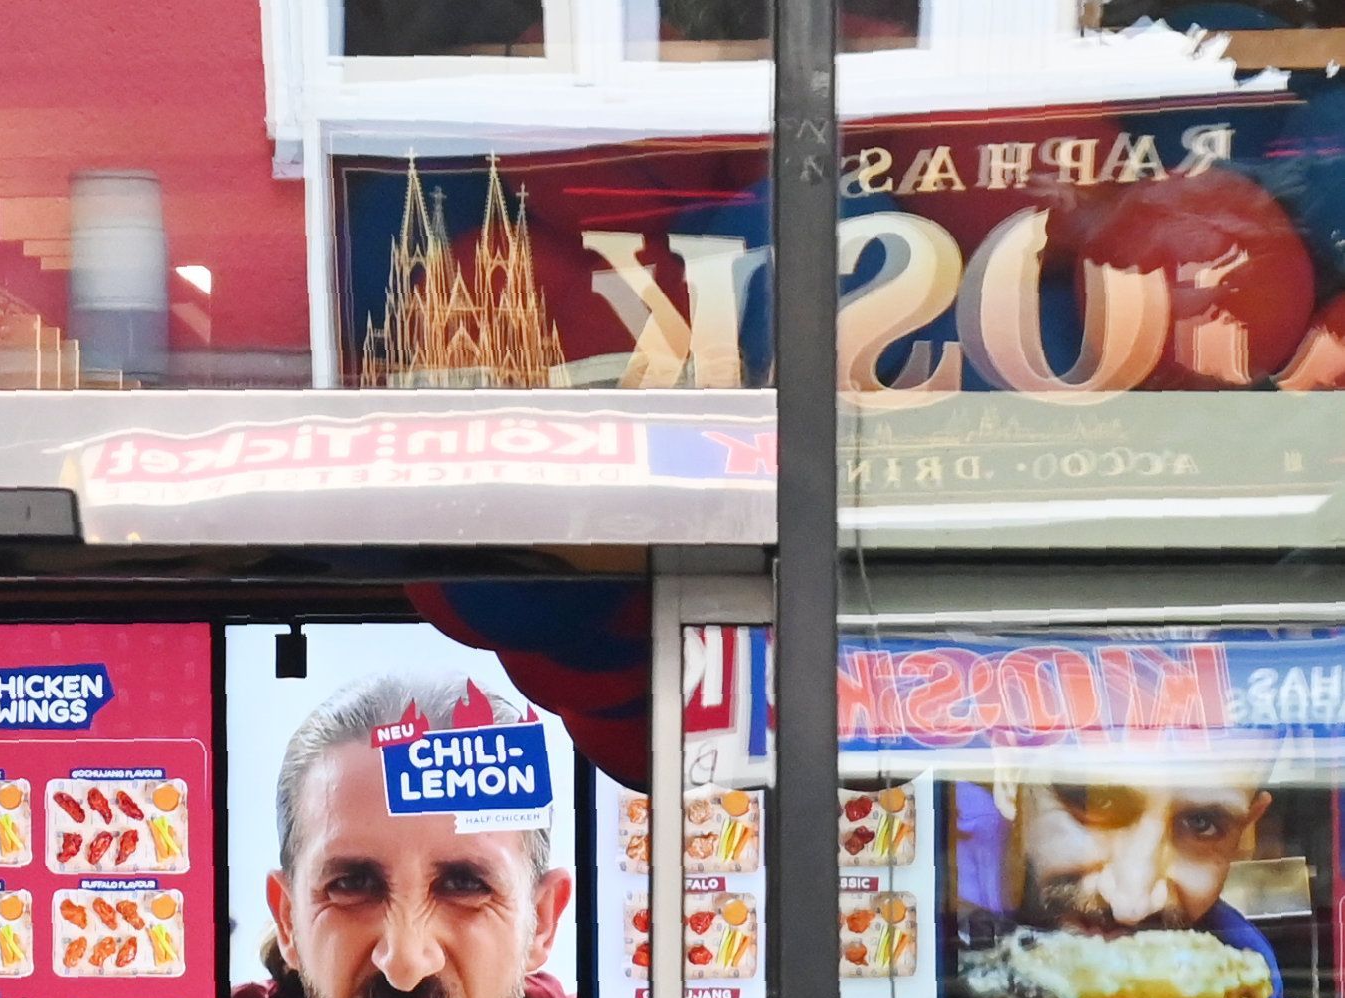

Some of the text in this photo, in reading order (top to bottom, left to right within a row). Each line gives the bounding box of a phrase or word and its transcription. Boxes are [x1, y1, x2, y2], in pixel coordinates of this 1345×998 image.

[377, 723, 415, 742] NEU
[408, 735, 524, 769] CHILI-
[400, 764, 535, 801] LEMON
